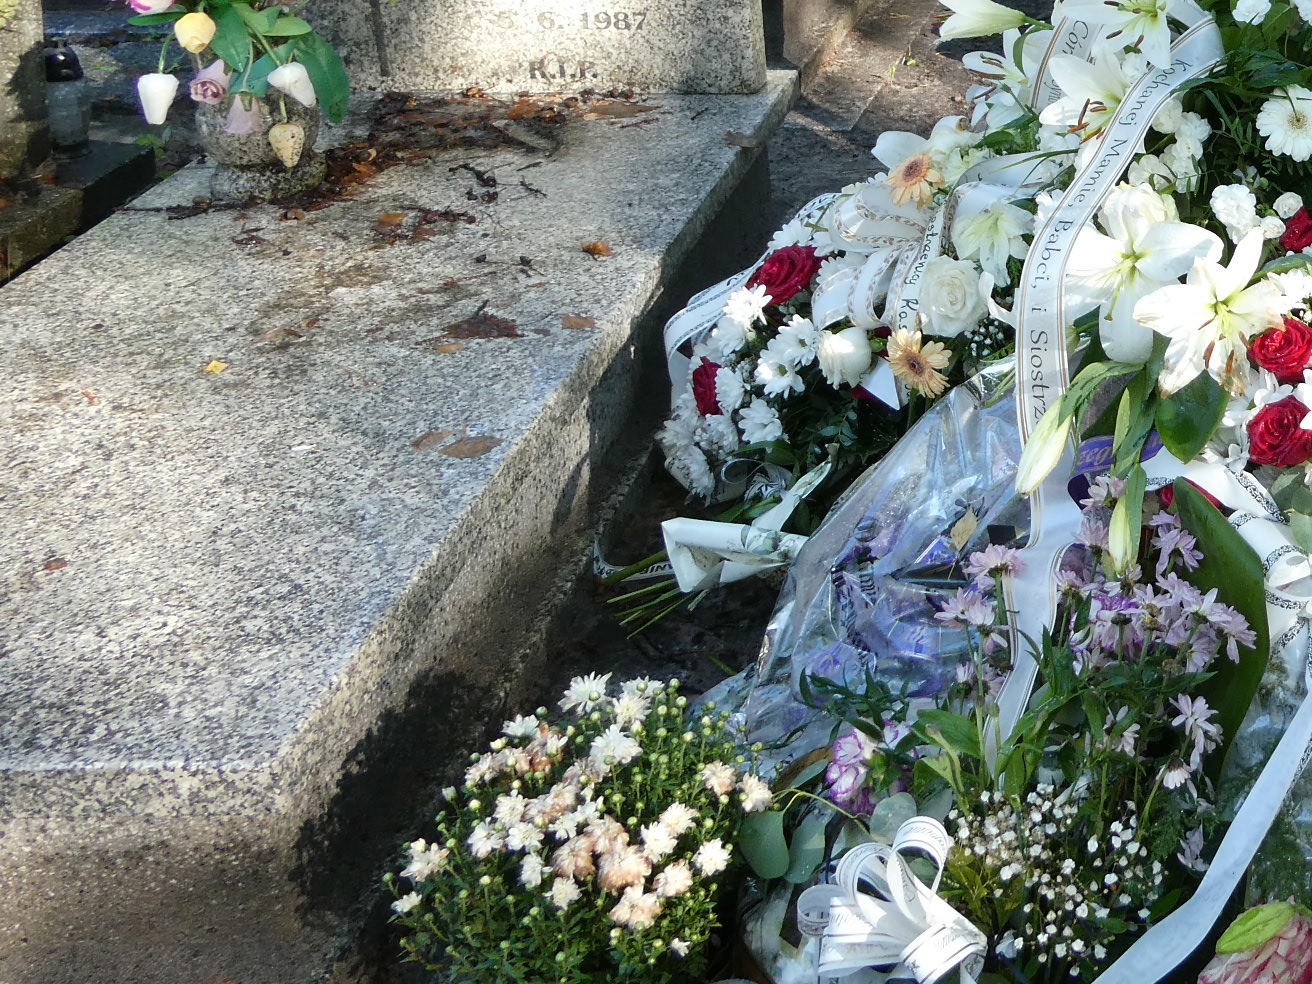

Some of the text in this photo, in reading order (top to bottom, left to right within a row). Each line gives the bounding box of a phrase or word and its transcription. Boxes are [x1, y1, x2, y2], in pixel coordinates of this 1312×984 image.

[1068, 137, 1128, 208] Mamie,
[1030, 218, 1074, 290] Babci,
[1029, 329, 1049, 421] Siostrz
